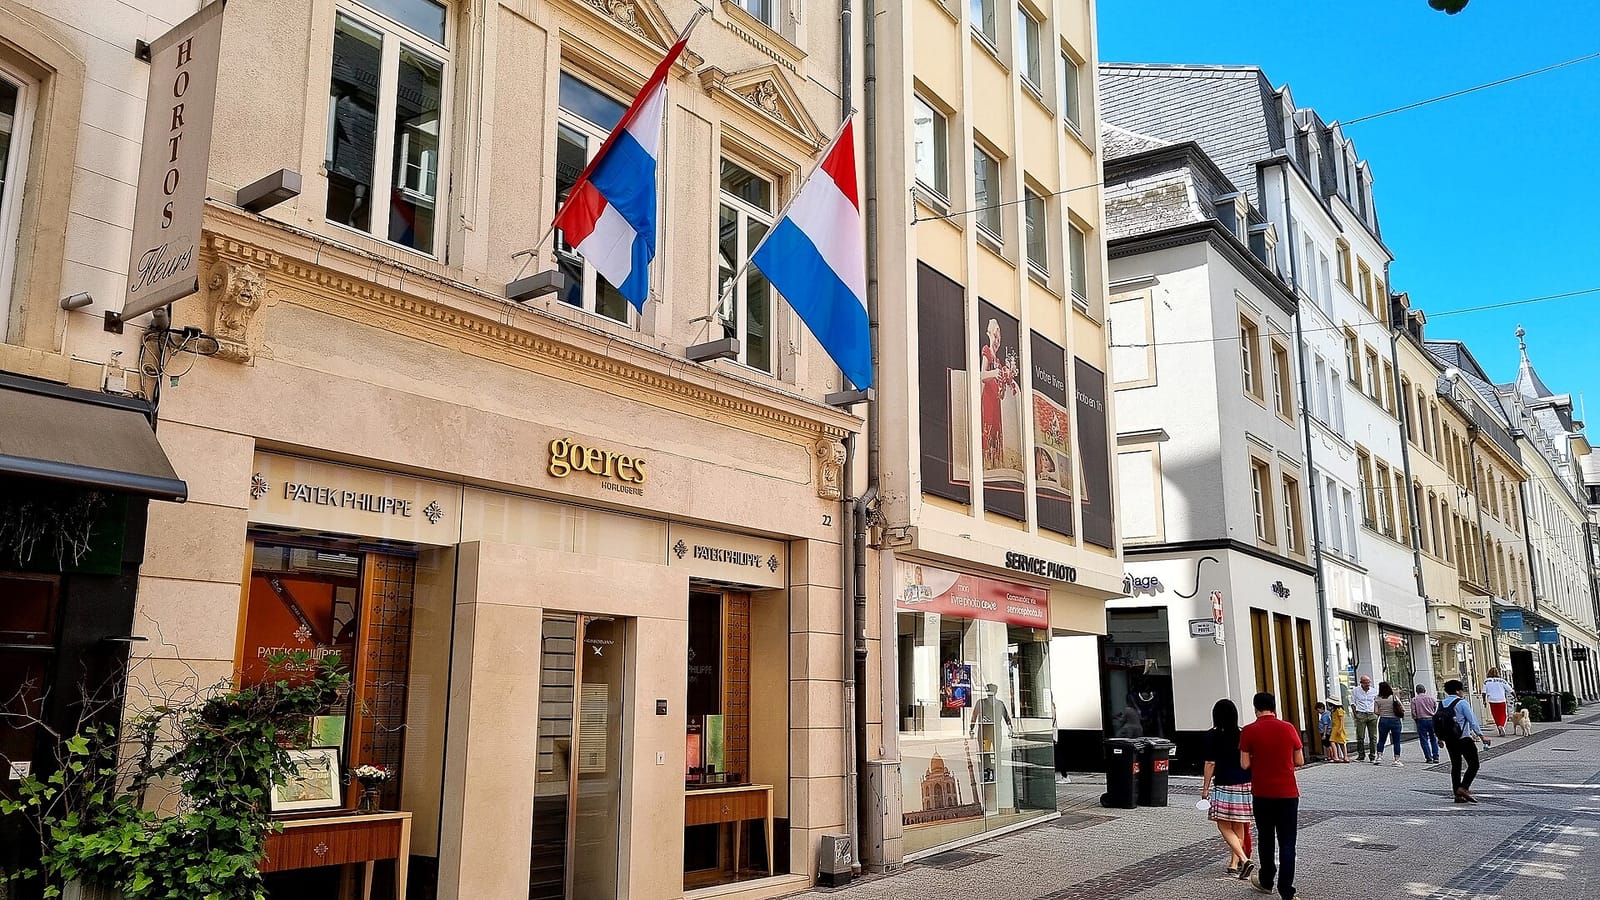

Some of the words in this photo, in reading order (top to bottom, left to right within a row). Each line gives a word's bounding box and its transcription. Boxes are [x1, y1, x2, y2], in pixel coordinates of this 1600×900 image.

[161, 36, 194, 229] HORTOS
[131, 241, 194, 293] Fleurs
[1034, 365, 1052, 384] Votre
[1052, 374, 1065, 391] livre
[1089, 397, 1096, 408] en
[284, 481, 339, 507] PATEK
[341, 490, 413, 518] PHILIPPE
[601, 481, 644, 496] HORLOGERIE
[822, 514, 832, 527] 22
[693, 545, 723, 563] PATEK
[723, 550, 763, 568] PHILIPPE
[1005, 551, 1047, 576] SERVICE
[1047, 561, 1077, 583] PHOTO
